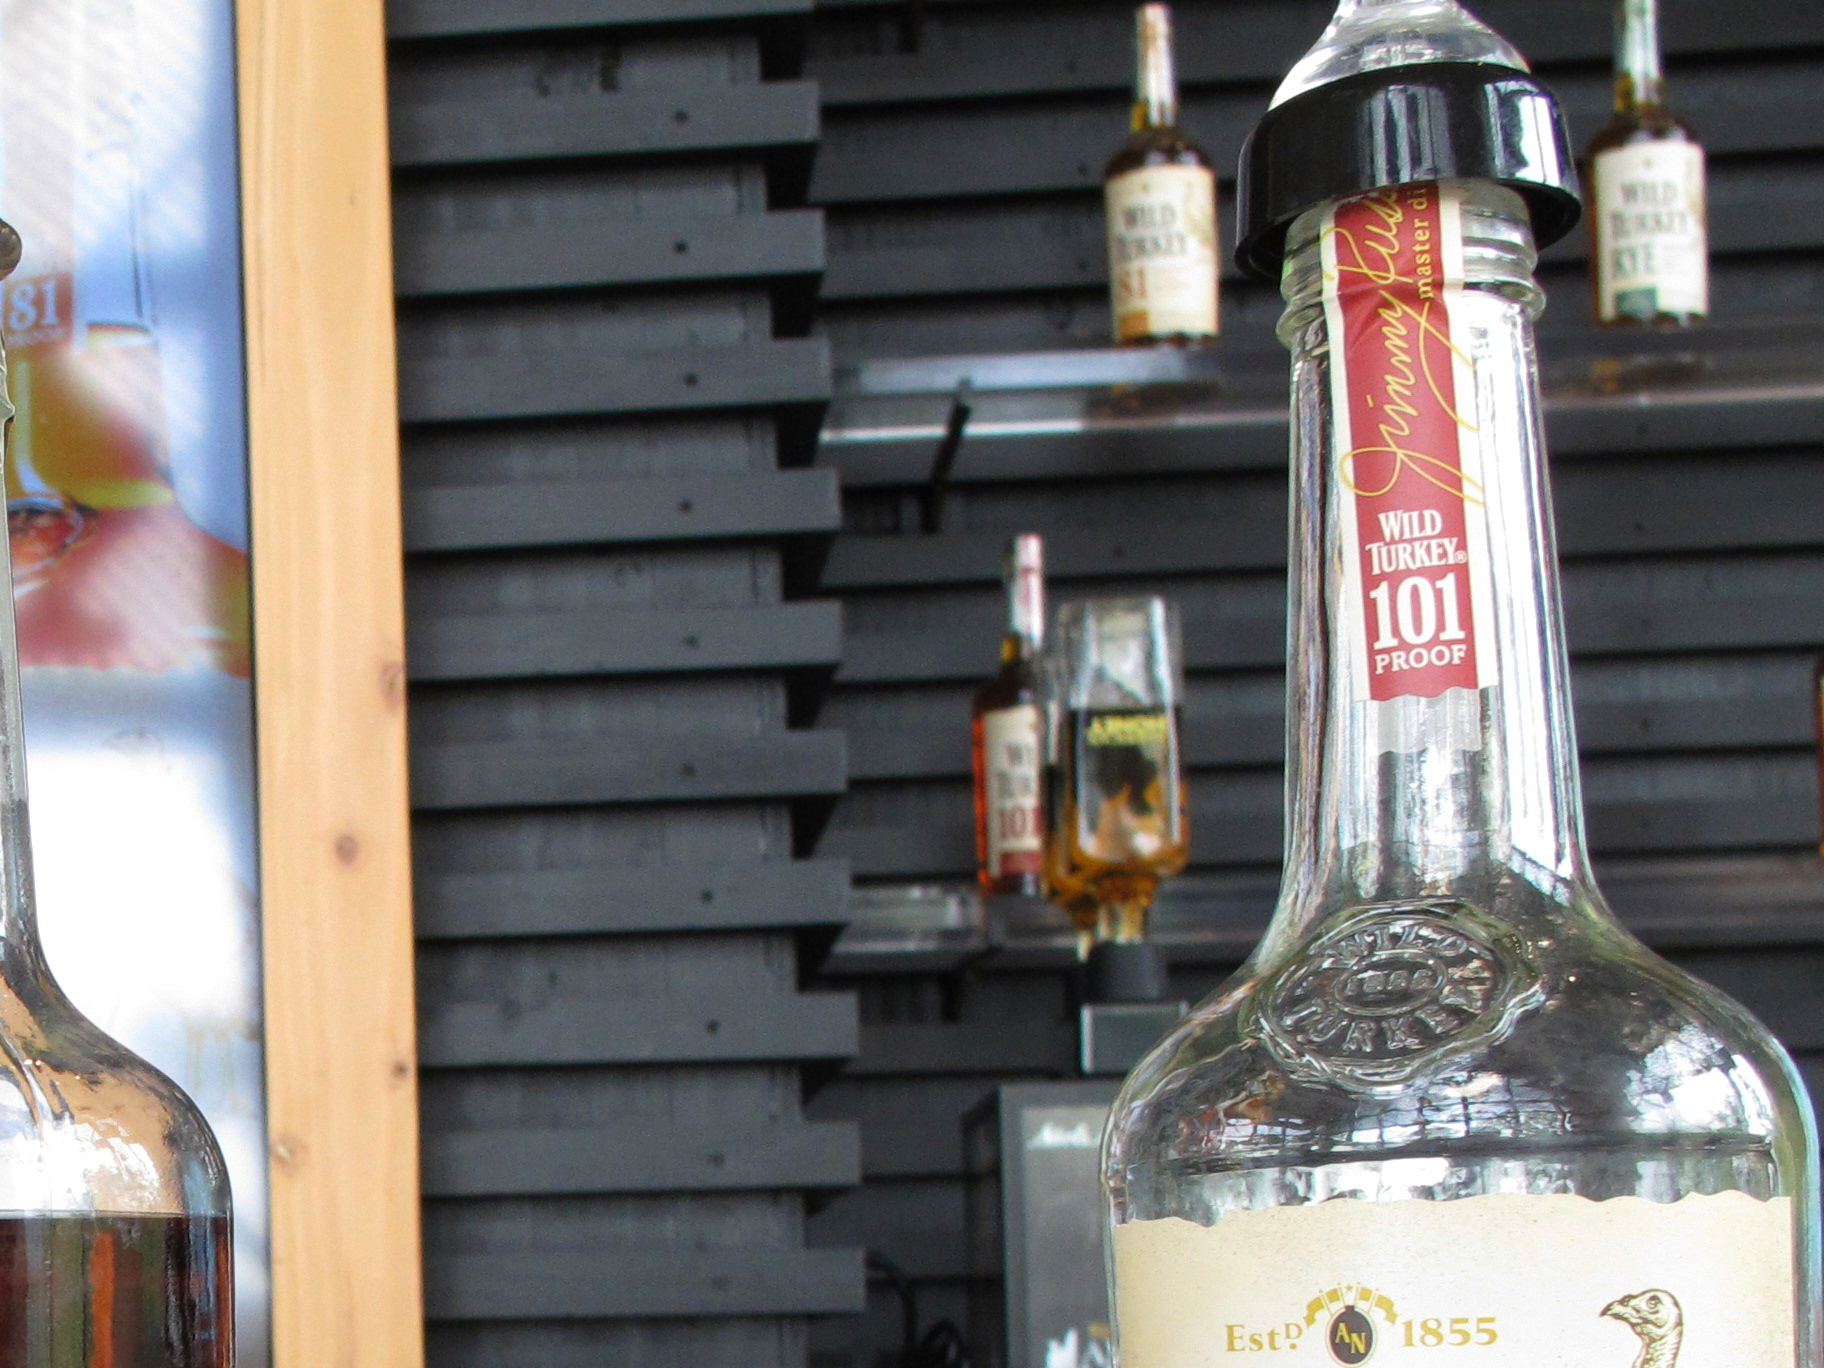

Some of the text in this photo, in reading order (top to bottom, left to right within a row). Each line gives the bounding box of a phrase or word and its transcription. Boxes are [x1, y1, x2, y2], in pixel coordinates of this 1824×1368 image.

[1412, 220, 1436, 300] master
[9, 279, 59, 332] 81
[1377, 508, 1444, 544] WILD
[1364, 537, 1459, 576] TURKEY
[1369, 572, 1466, 651] 101
[1375, 644, 1468, 675] PROOF
[1399, 1316, 1500, 1350] 1855
